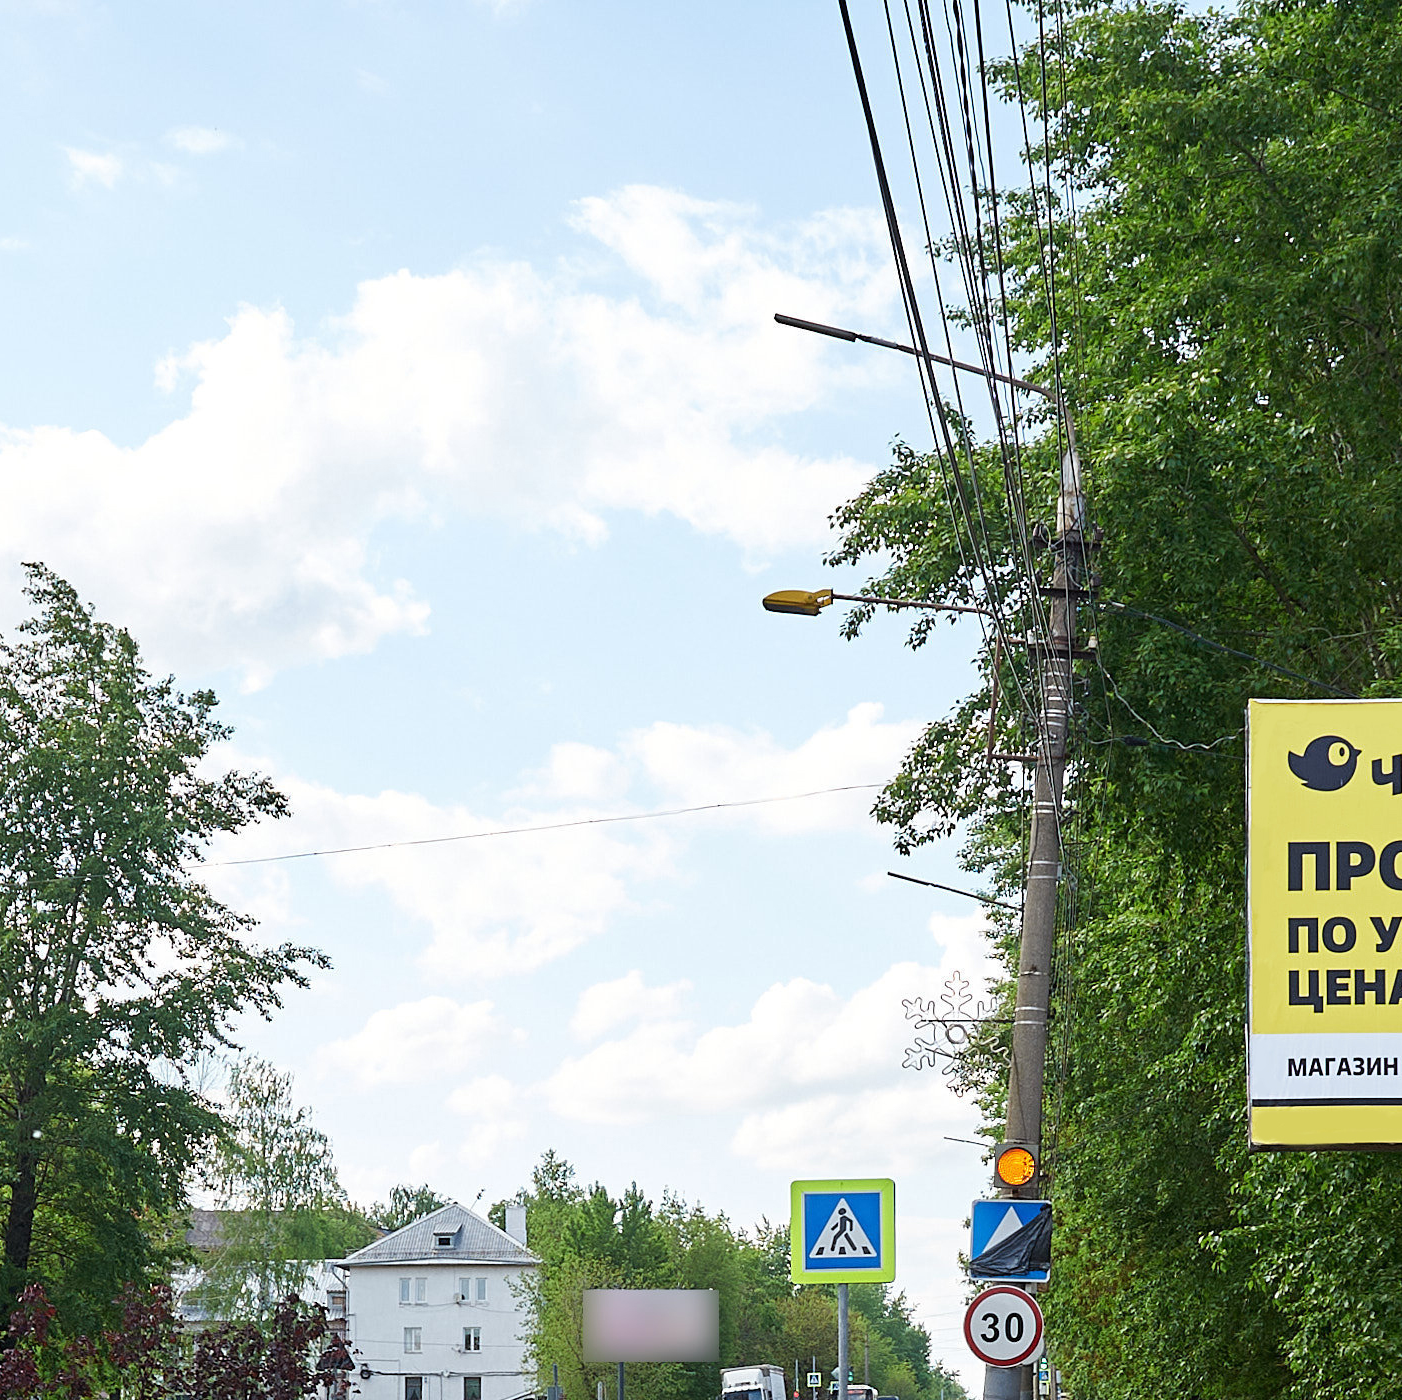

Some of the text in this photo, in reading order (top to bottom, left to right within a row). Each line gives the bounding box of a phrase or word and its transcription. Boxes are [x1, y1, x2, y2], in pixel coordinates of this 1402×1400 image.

[1287, 916, 1357, 954] ПО
[1287, 1057, 1398, 1077] МАГАЗИН
[980, 1312, 1024, 1343] 30
